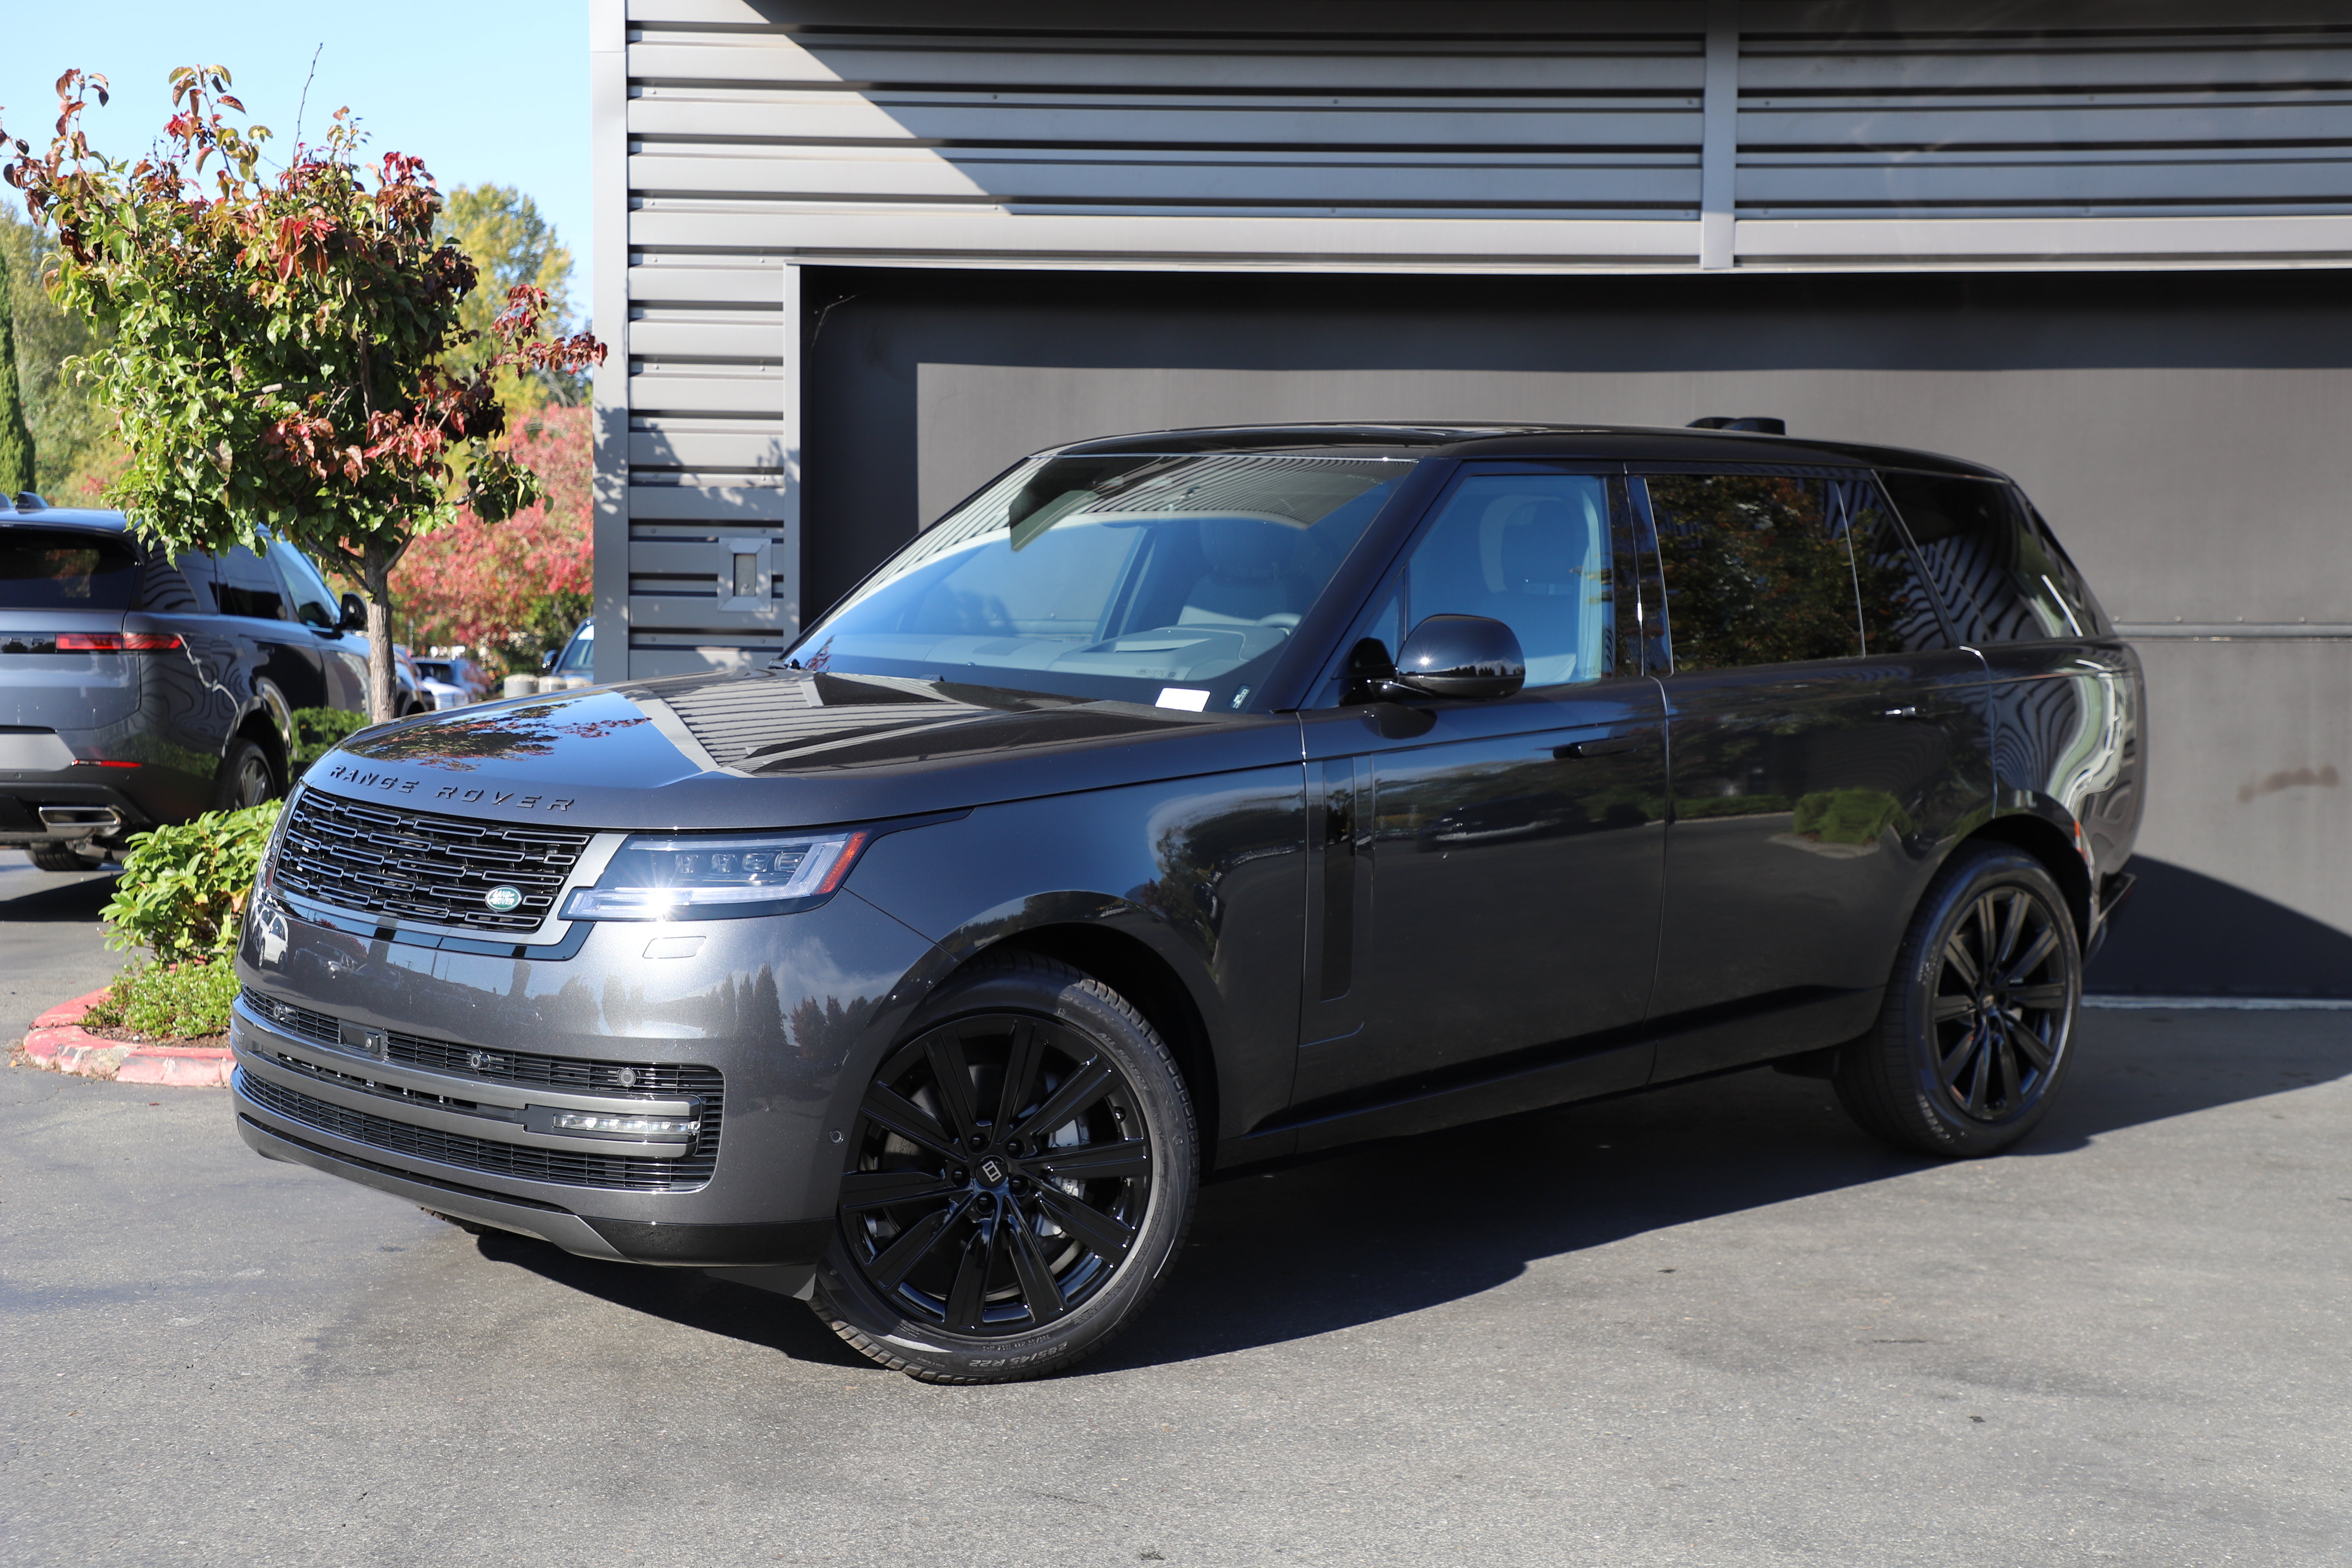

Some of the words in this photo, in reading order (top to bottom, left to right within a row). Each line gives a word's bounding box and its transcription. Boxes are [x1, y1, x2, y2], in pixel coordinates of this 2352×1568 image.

[329, 764, 419, 793] RANGE
[435, 786, 575, 811] ROVER
[1097, 1033, 1116, 1047] ALL
[1116, 1049, 1150, 1092] SEASON
[915, 1356, 946, 1368] OUTSIDE
[968, 1359, 1005, 1368] R22
[1009, 1341, 1068, 1366] 285/45
